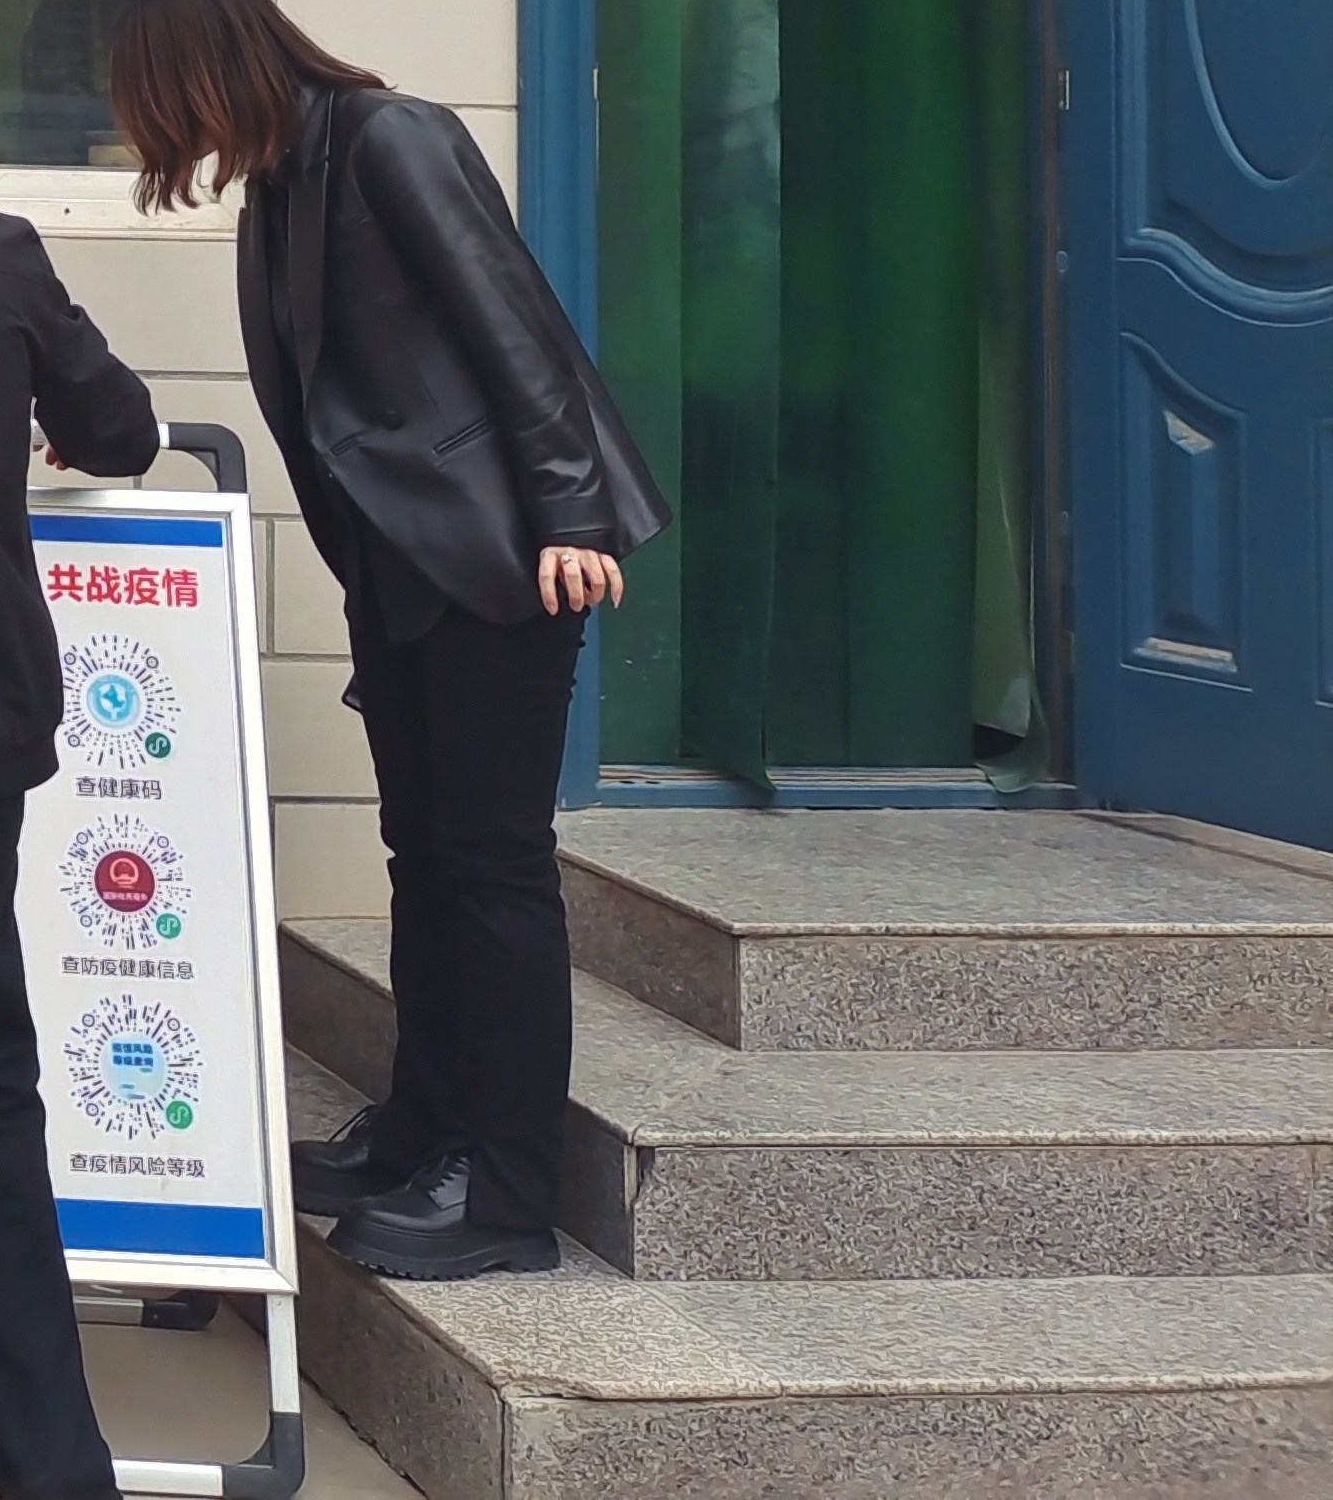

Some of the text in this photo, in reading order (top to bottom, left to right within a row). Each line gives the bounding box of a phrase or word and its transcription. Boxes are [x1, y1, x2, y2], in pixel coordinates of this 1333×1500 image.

[47, 564, 199, 607] 共战疫情
[76, 776, 163, 800] 查健康码
[61, 956, 195, 980] 查防疫健康信息
[69, 1152, 206, 1179] 查疫情风险等级
